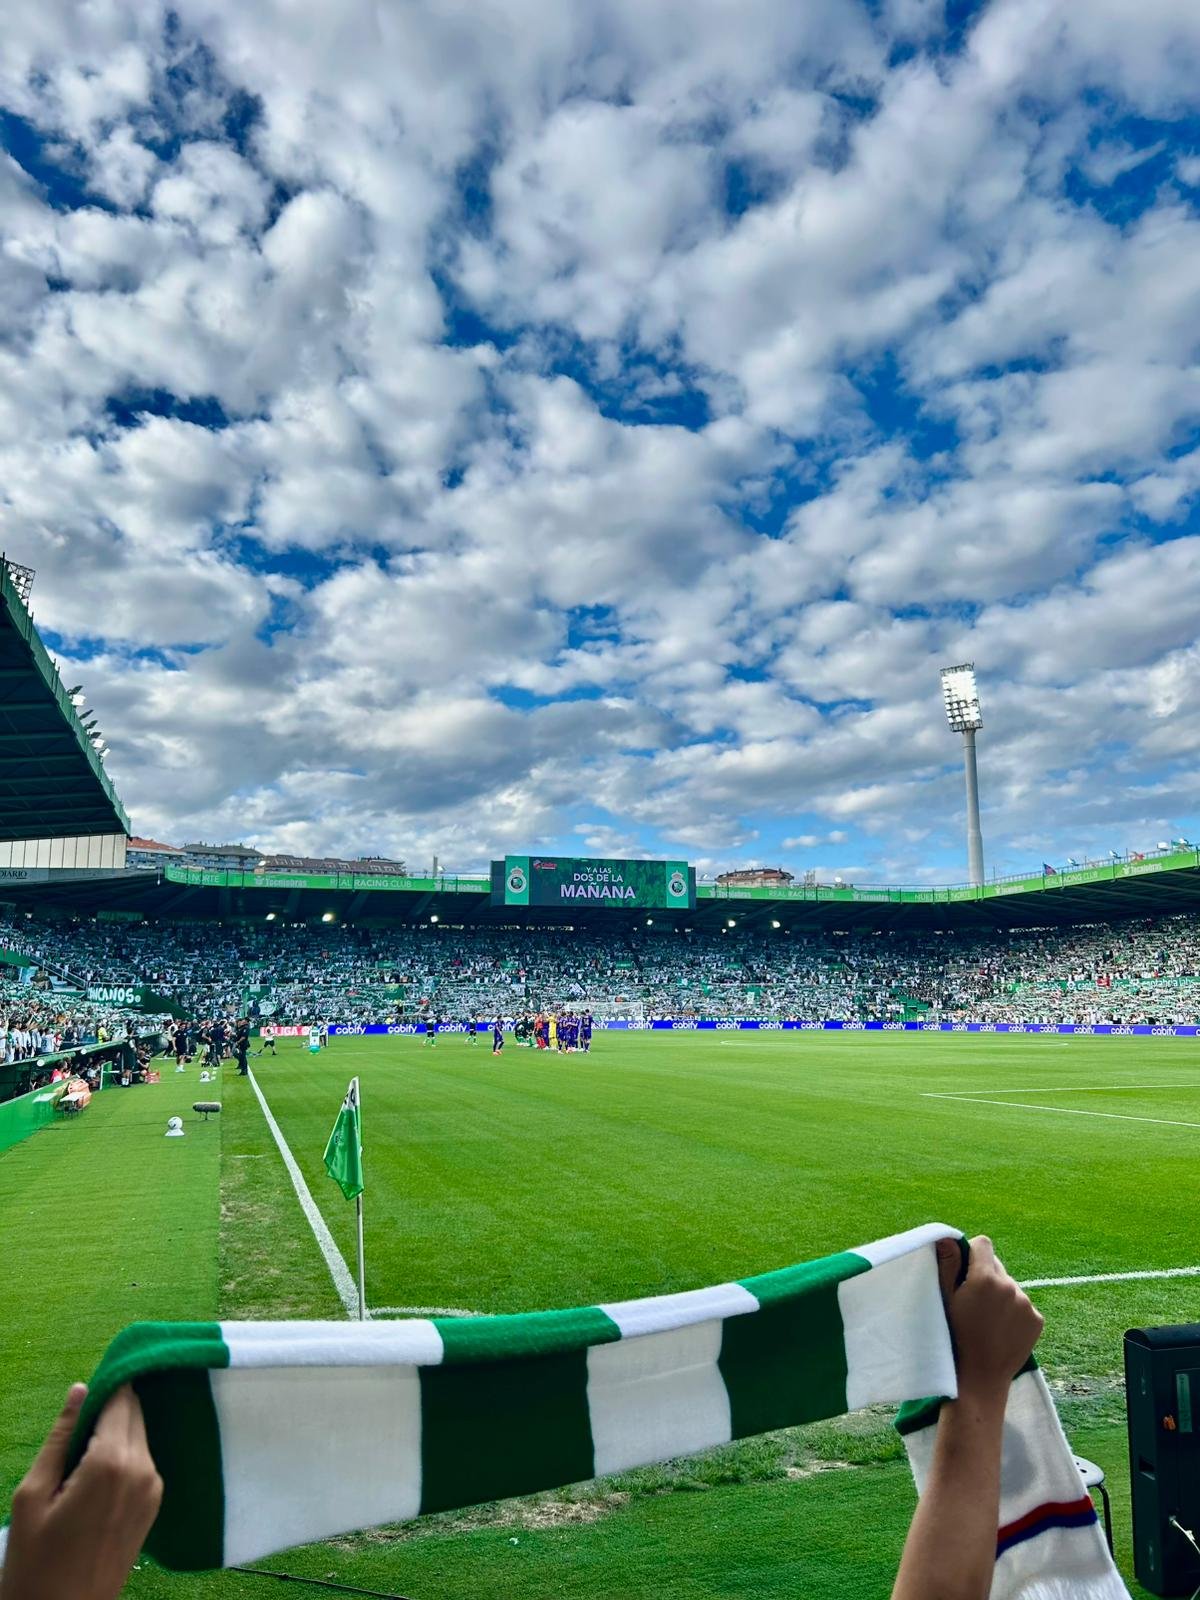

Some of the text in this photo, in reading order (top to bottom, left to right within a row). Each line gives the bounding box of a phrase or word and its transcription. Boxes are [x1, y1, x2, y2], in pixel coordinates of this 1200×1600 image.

[573, 873, 624, 883] DOS DE LA
[354, 879, 388, 889] RACING
[389, 880, 412, 889] CLUB
[560, 881, 636, 899] MAÑANA
[335, 1024, 366, 1034] cabify
[387, 1024, 418, 1034] cabify
[438, 1023, 467, 1033] cabify
[627, 1021, 654, 1030] cabify
[672, 1021, 698, 1030] cabify
[716, 1021, 742, 1030] cabify
[758, 1021, 784, 1030] cabify
[800, 1021, 826, 1030] cabify
[842, 1021, 867, 1030] cabify
[882, 1021, 907, 1031] cabify
[1073, 1025, 1096, 1035] cabify
[1111, 1025, 1135, 1036] cabify
[1151, 1026, 1177, 1037] cabify
